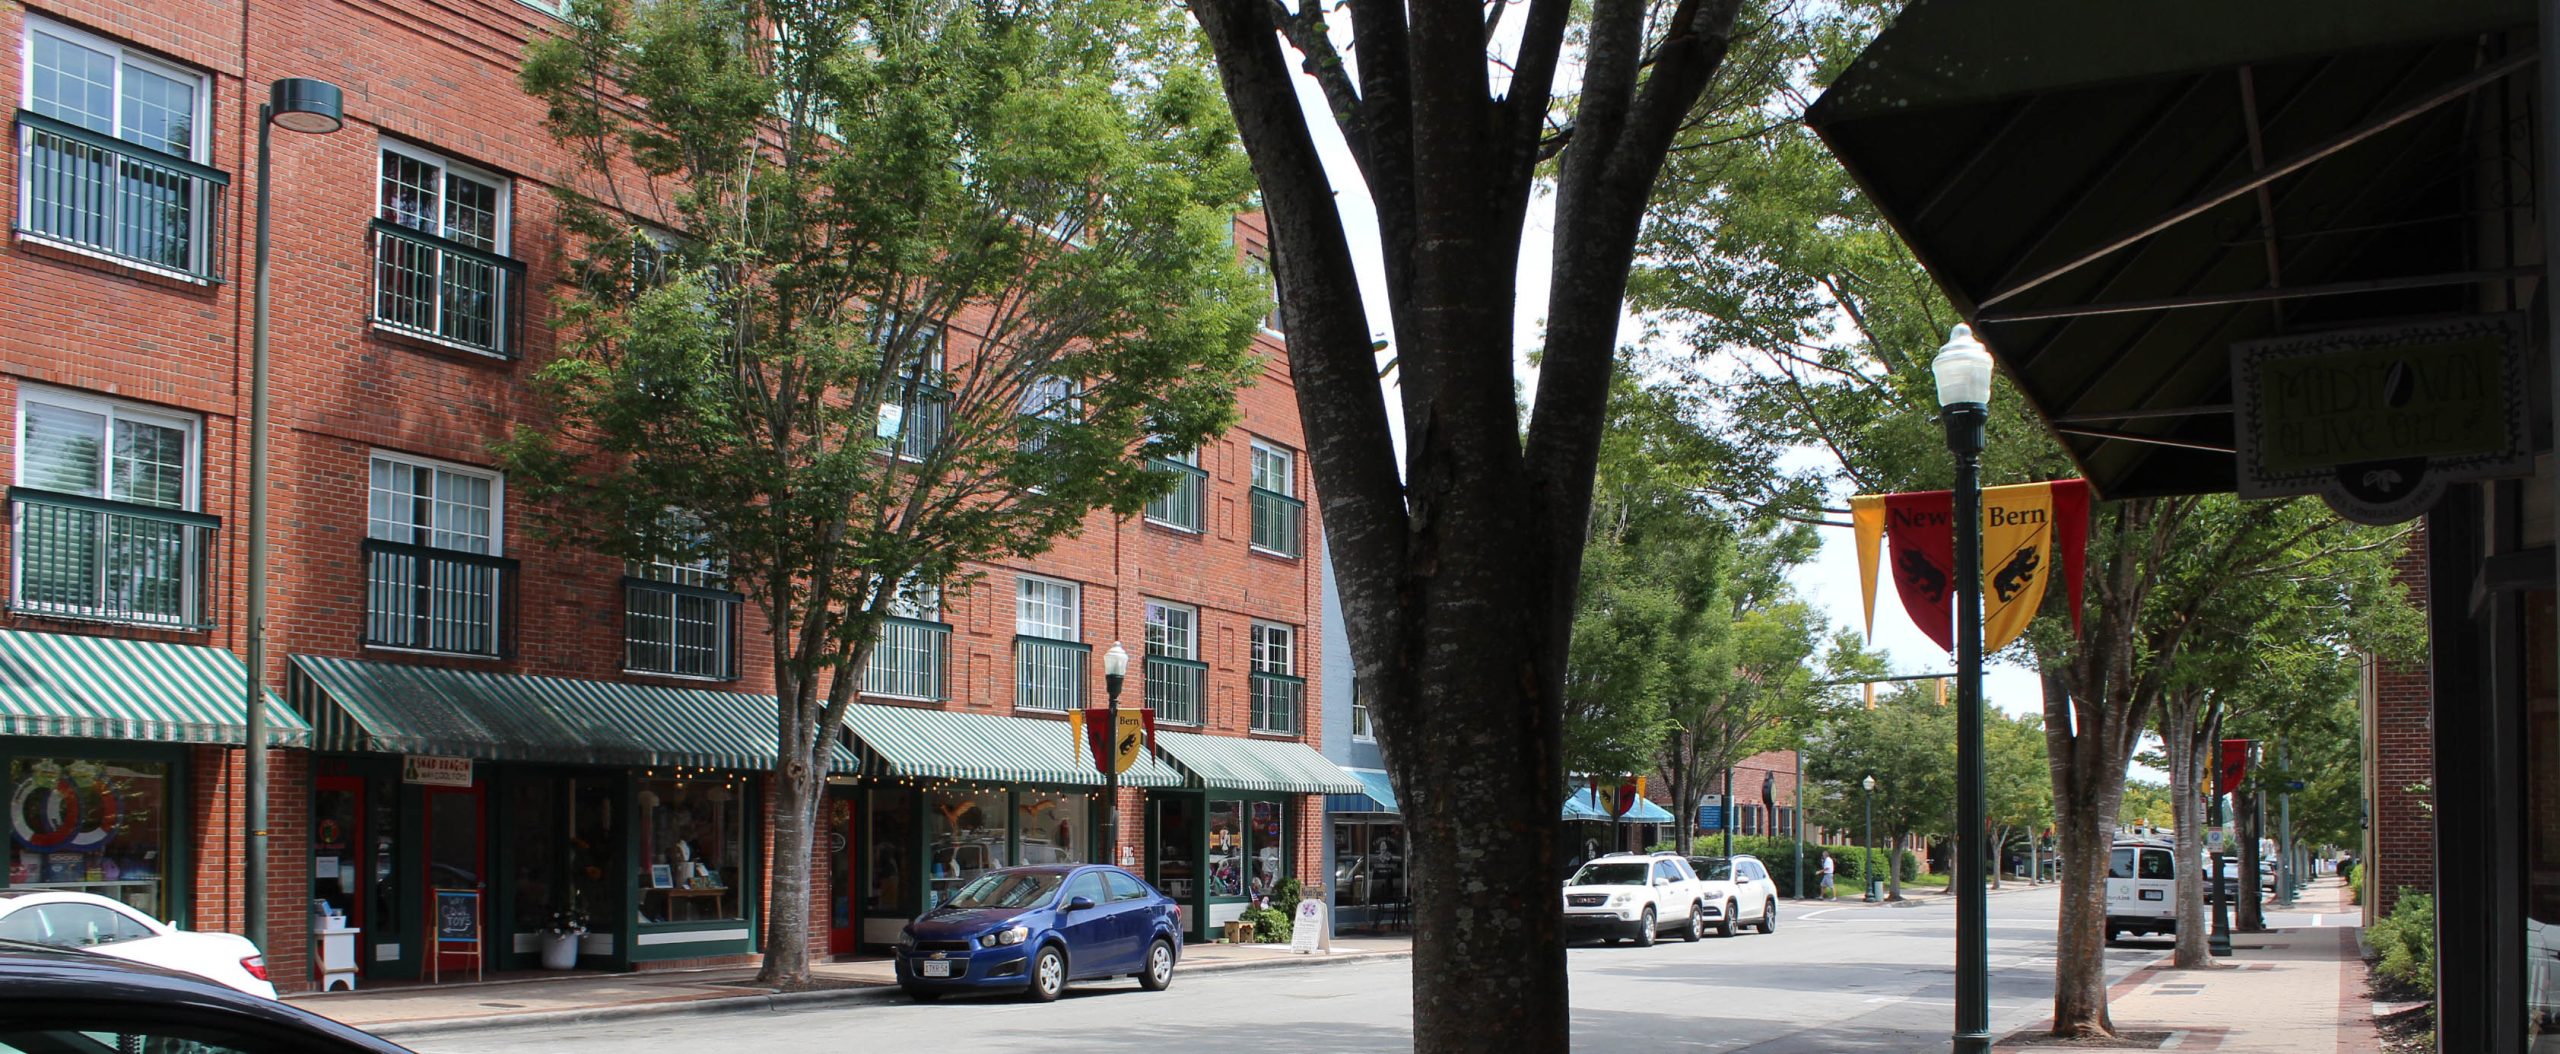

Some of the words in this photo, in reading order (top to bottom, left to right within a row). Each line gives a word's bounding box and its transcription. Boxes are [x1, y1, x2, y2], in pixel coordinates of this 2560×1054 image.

[1892, 507, 1948, 529] New
[1989, 506, 2046, 528] Bern
[1120, 716, 1139, 726] Bern
[447, 916, 472, 927] TOYS
